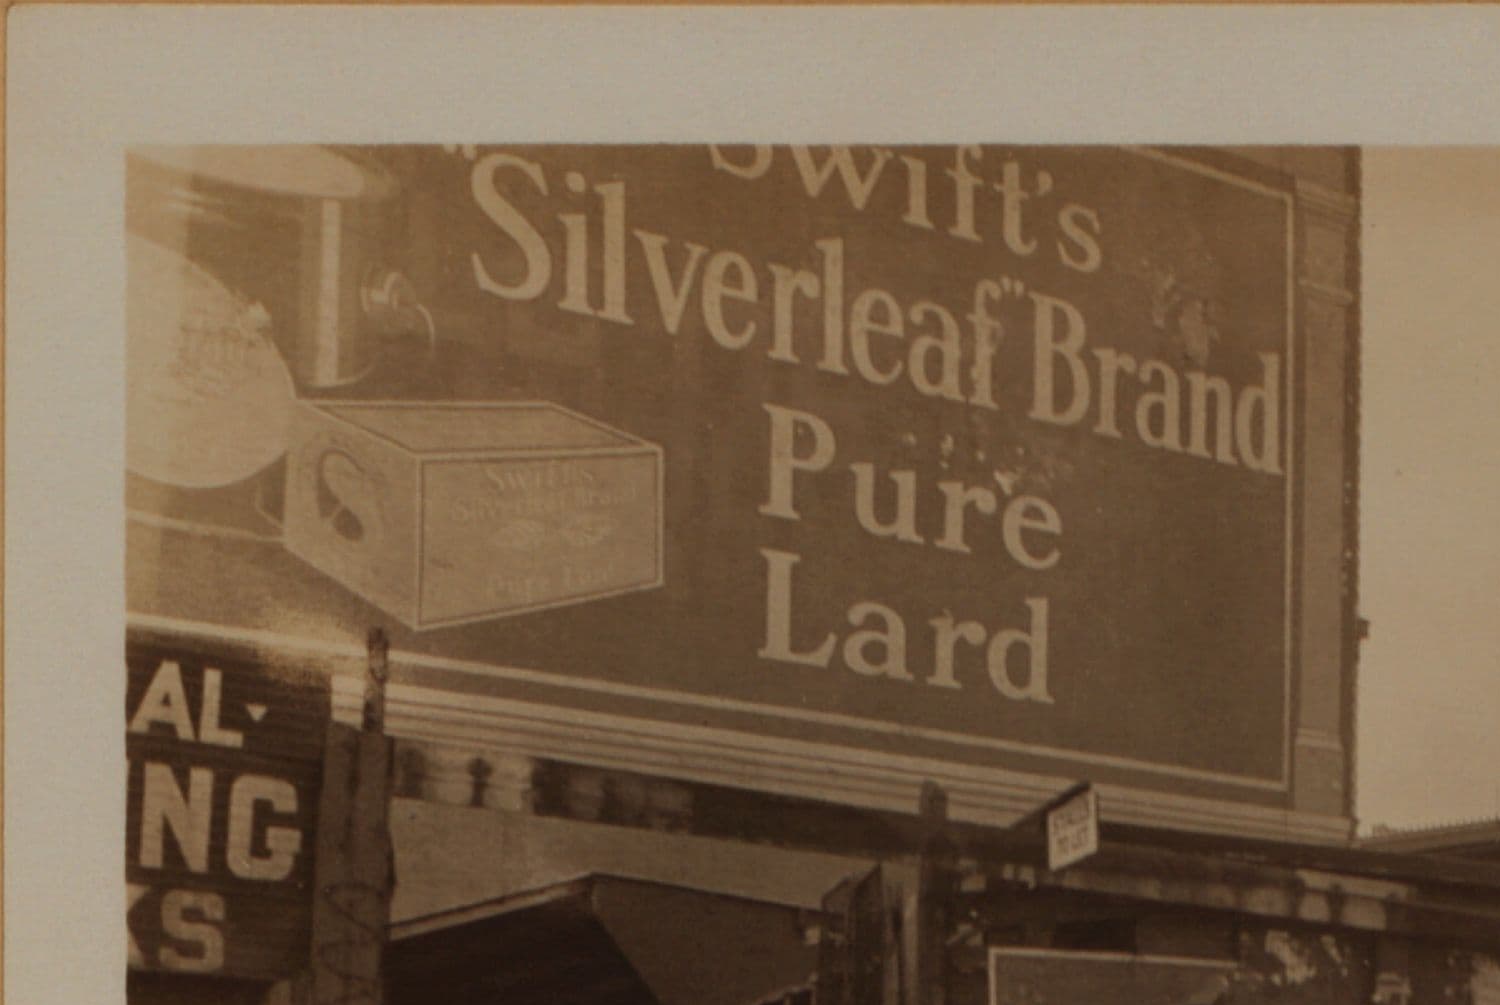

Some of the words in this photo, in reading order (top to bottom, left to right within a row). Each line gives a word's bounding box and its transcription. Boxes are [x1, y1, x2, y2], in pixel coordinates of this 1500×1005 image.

[1029, 289, 1285, 476] Brand
[758, 402, 1063, 570] Pure
[757, 548, 1056, 705] Lard
